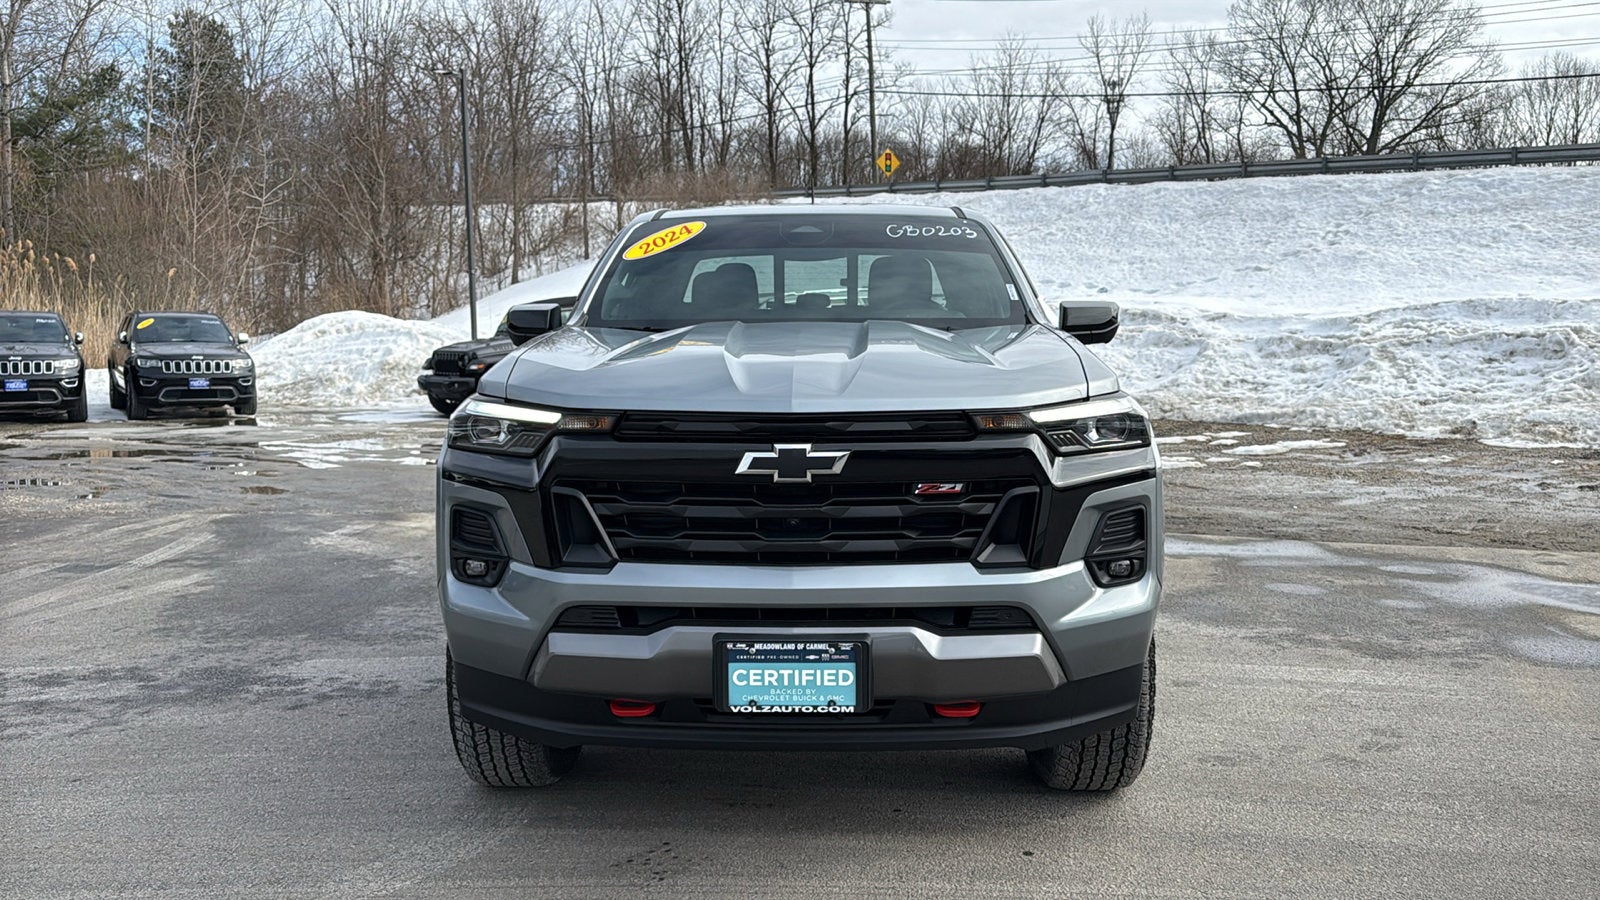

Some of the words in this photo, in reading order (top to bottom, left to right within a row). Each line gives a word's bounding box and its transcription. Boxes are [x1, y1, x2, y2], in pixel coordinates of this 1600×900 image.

[886, 224, 978, 239] GB0203
[638, 224, 694, 256] 2024
[914, 483, 964, 494] Z71
[732, 669, 854, 686] CERTIFIED
